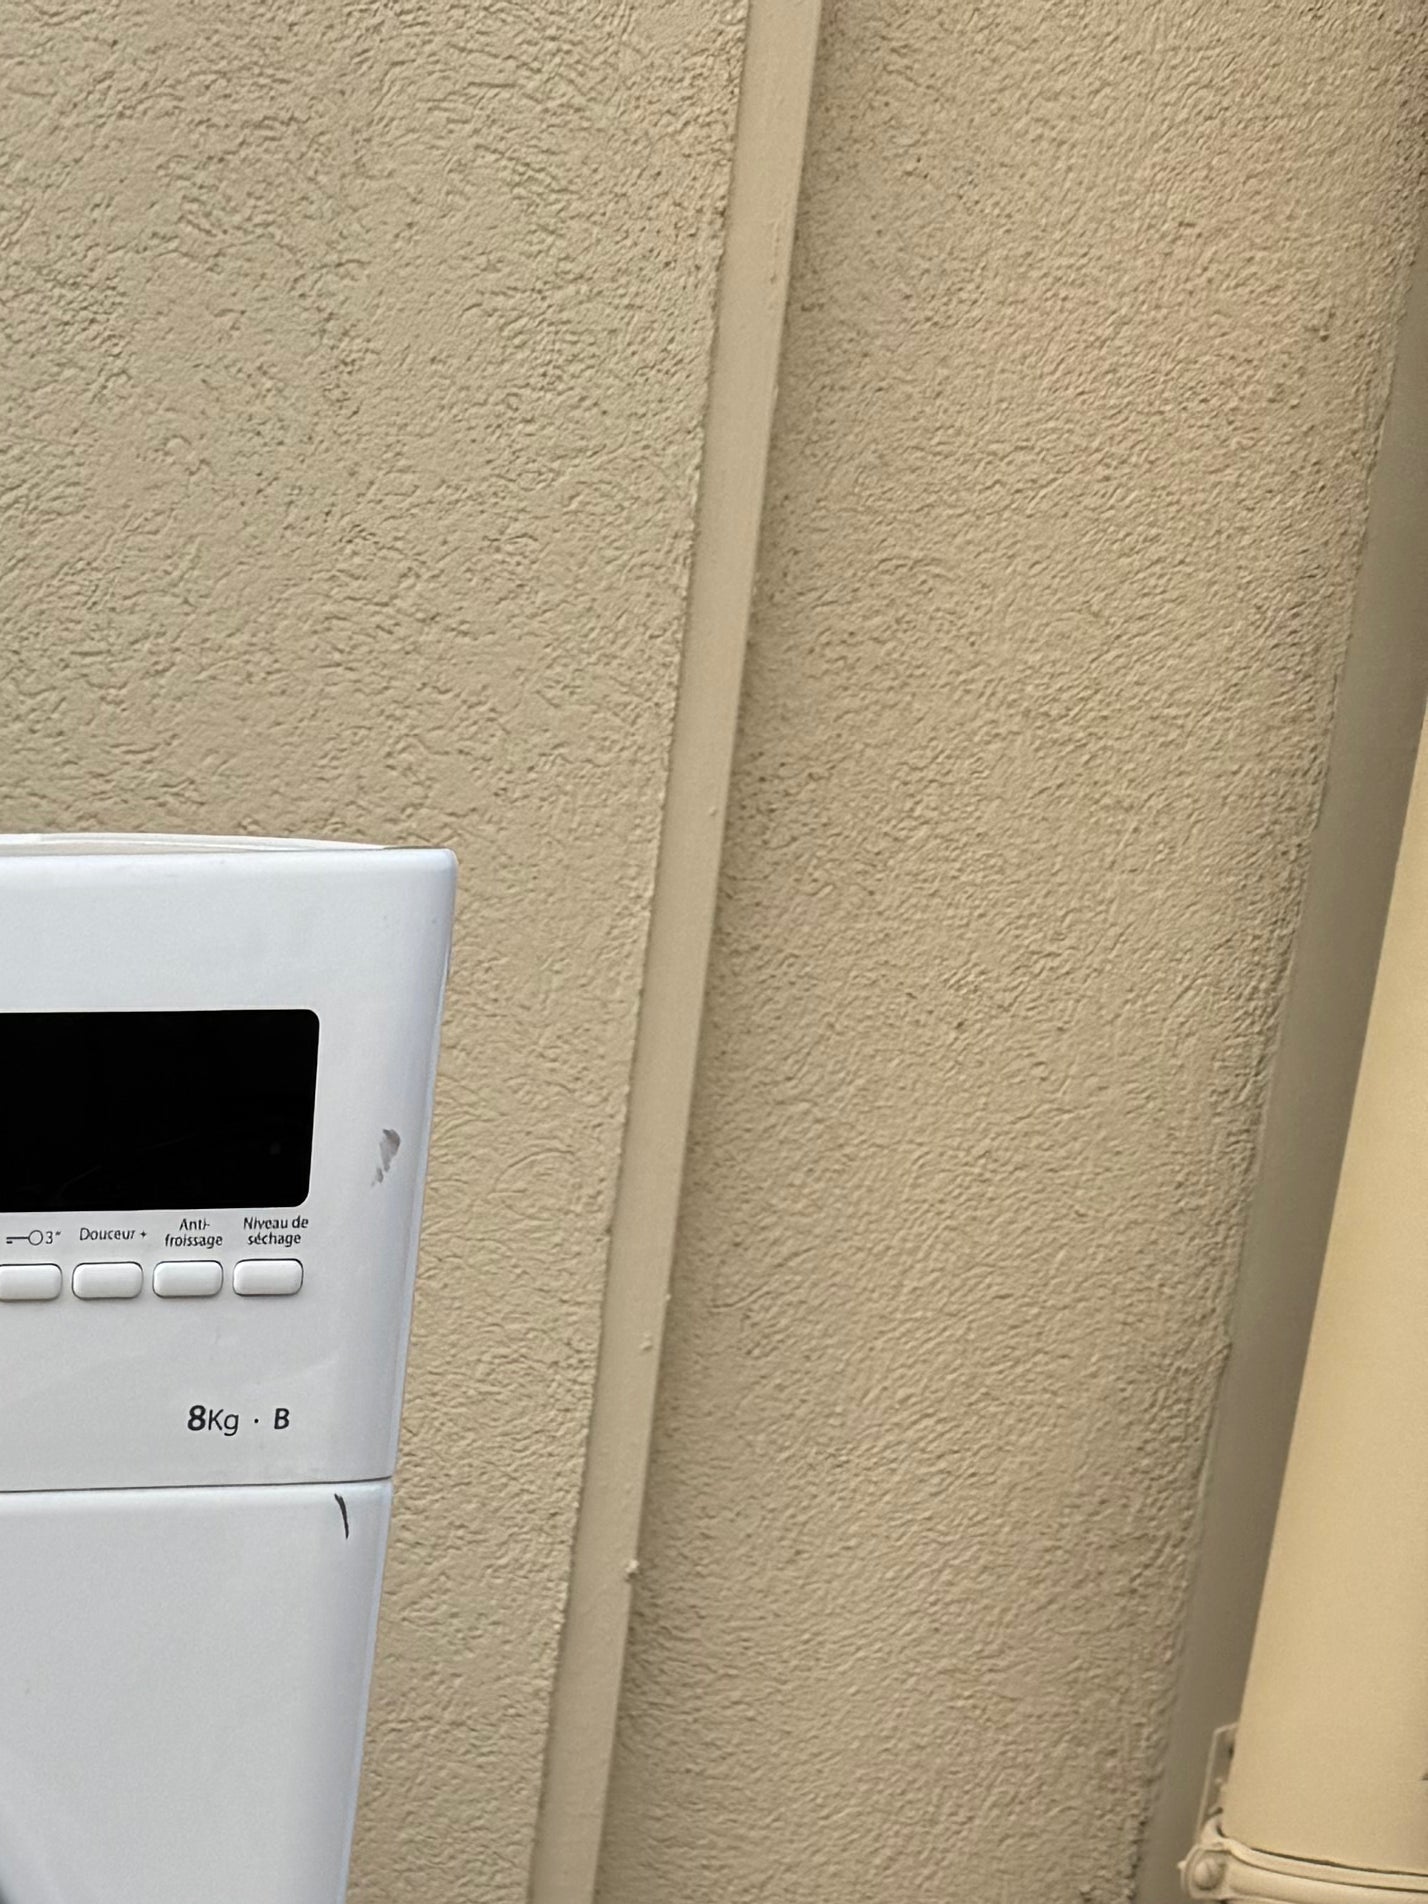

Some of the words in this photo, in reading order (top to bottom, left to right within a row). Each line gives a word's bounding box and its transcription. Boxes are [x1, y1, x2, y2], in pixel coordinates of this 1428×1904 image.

[179, 1217, 210, 1231] Anti-
[242, 1216, 289, 1230] Niveau
[291, 1215, 309, 1229] de
[79, 1227, 135, 1242] Douceur
[164, 1233, 223, 1250] froissage
[247, 1231, 302, 1247] séchage
[187, 1404, 239, 1437] 8Kg
[273, 1407, 290, 1430] B
